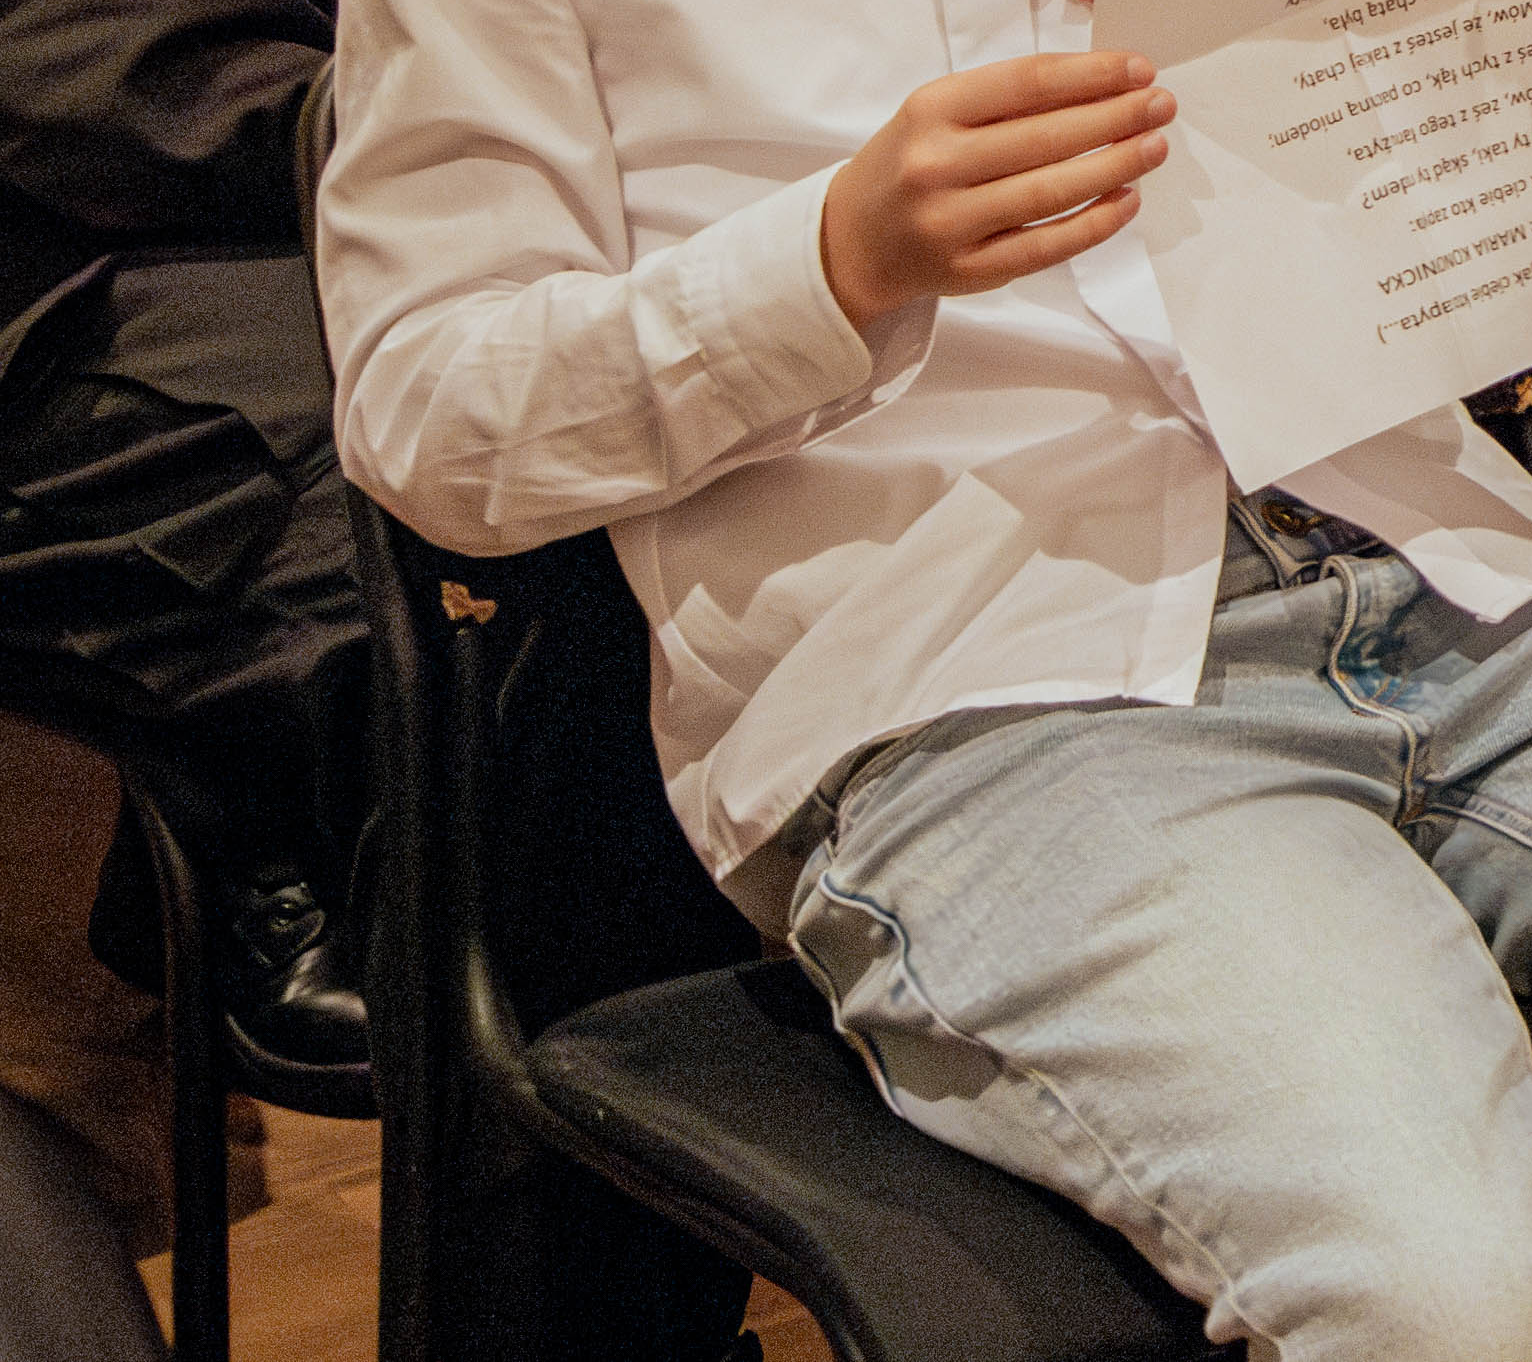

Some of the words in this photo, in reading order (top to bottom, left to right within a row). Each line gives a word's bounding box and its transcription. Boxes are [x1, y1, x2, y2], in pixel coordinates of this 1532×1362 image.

[1321, 8, 1365, 33] była,
[1461, 14, 1483, 35] że
[1391, 40, 1404, 55] z
[1405, 19, 1460, 56] jesteś
[1460, 53, 1502, 80] tych
[1502, 50, 1514, 65] z
[1292, 61, 1346, 91] chaty,
[1400, 79, 1423, 98] co
[1425, 67, 1459, 91] łąk,
[1458, 108, 1469, 123] z
[1471, 98, 1502, 123] żeś
[1267, 108, 1344, 149] miodem;
[1418, 113, 1458, 137] tego
[1346, 135, 1393, 162] żyta,
[1471, 140, 1510, 166] taki,
[1512, 131, 1532, 151] ty
[1431, 153, 1470, 181] skąd
[1477, 178, 1529, 207] ciebie
[1449, 197, 1478, 217] kto
[1470, 223, 1528, 257] MARIA
